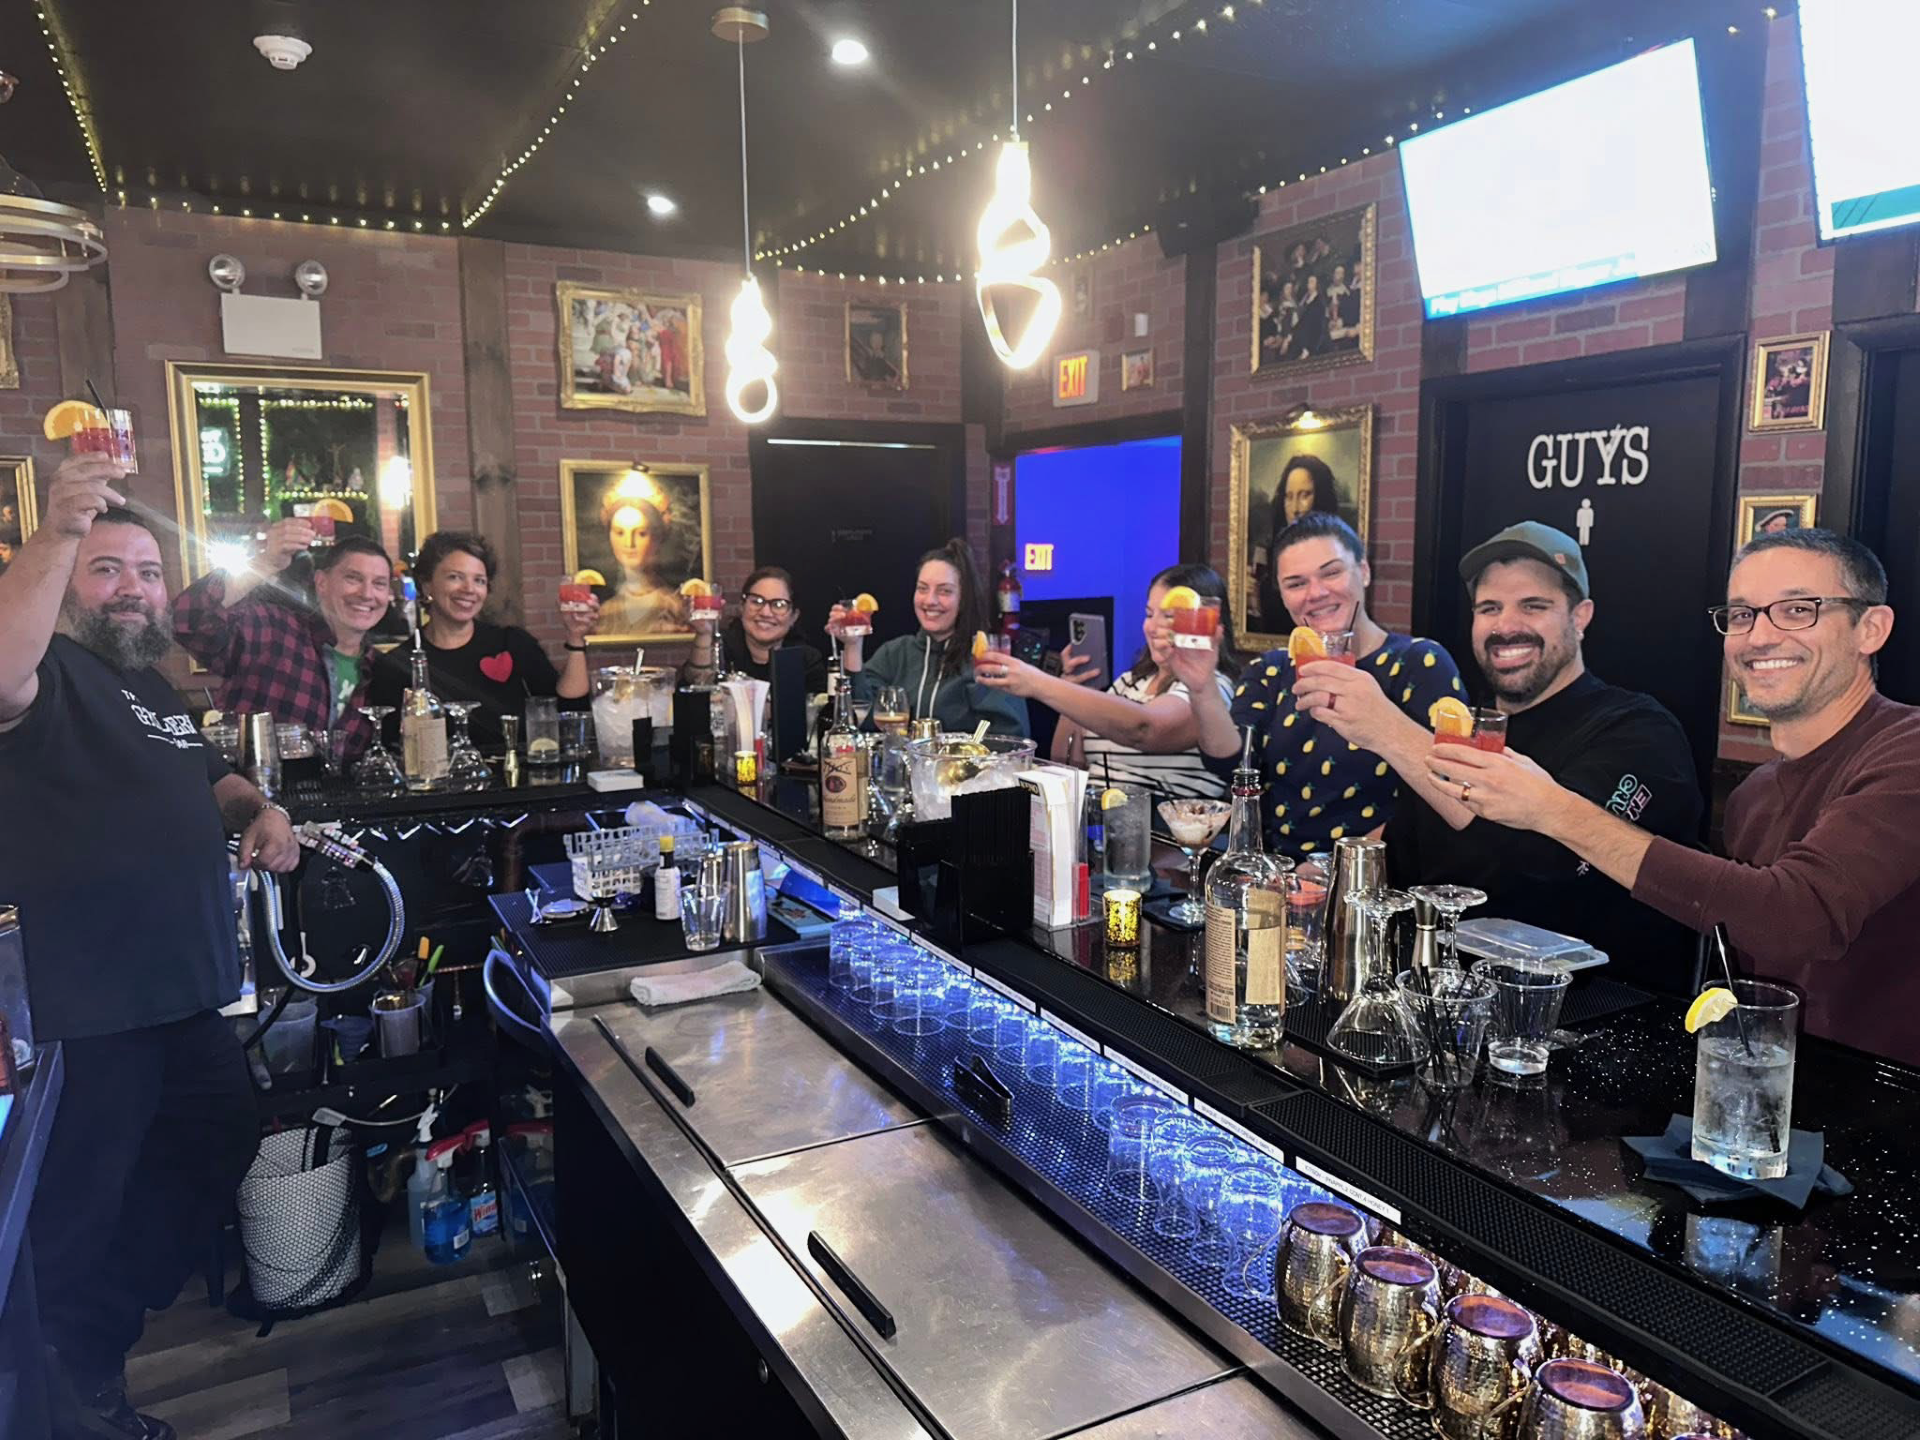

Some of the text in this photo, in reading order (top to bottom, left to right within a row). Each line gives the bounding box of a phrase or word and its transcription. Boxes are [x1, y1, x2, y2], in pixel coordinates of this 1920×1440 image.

[1058, 355, 1088, 399] EXIT
[1527, 425, 1650, 490] GUYS
[1024, 544, 1054, 571] EXIT
